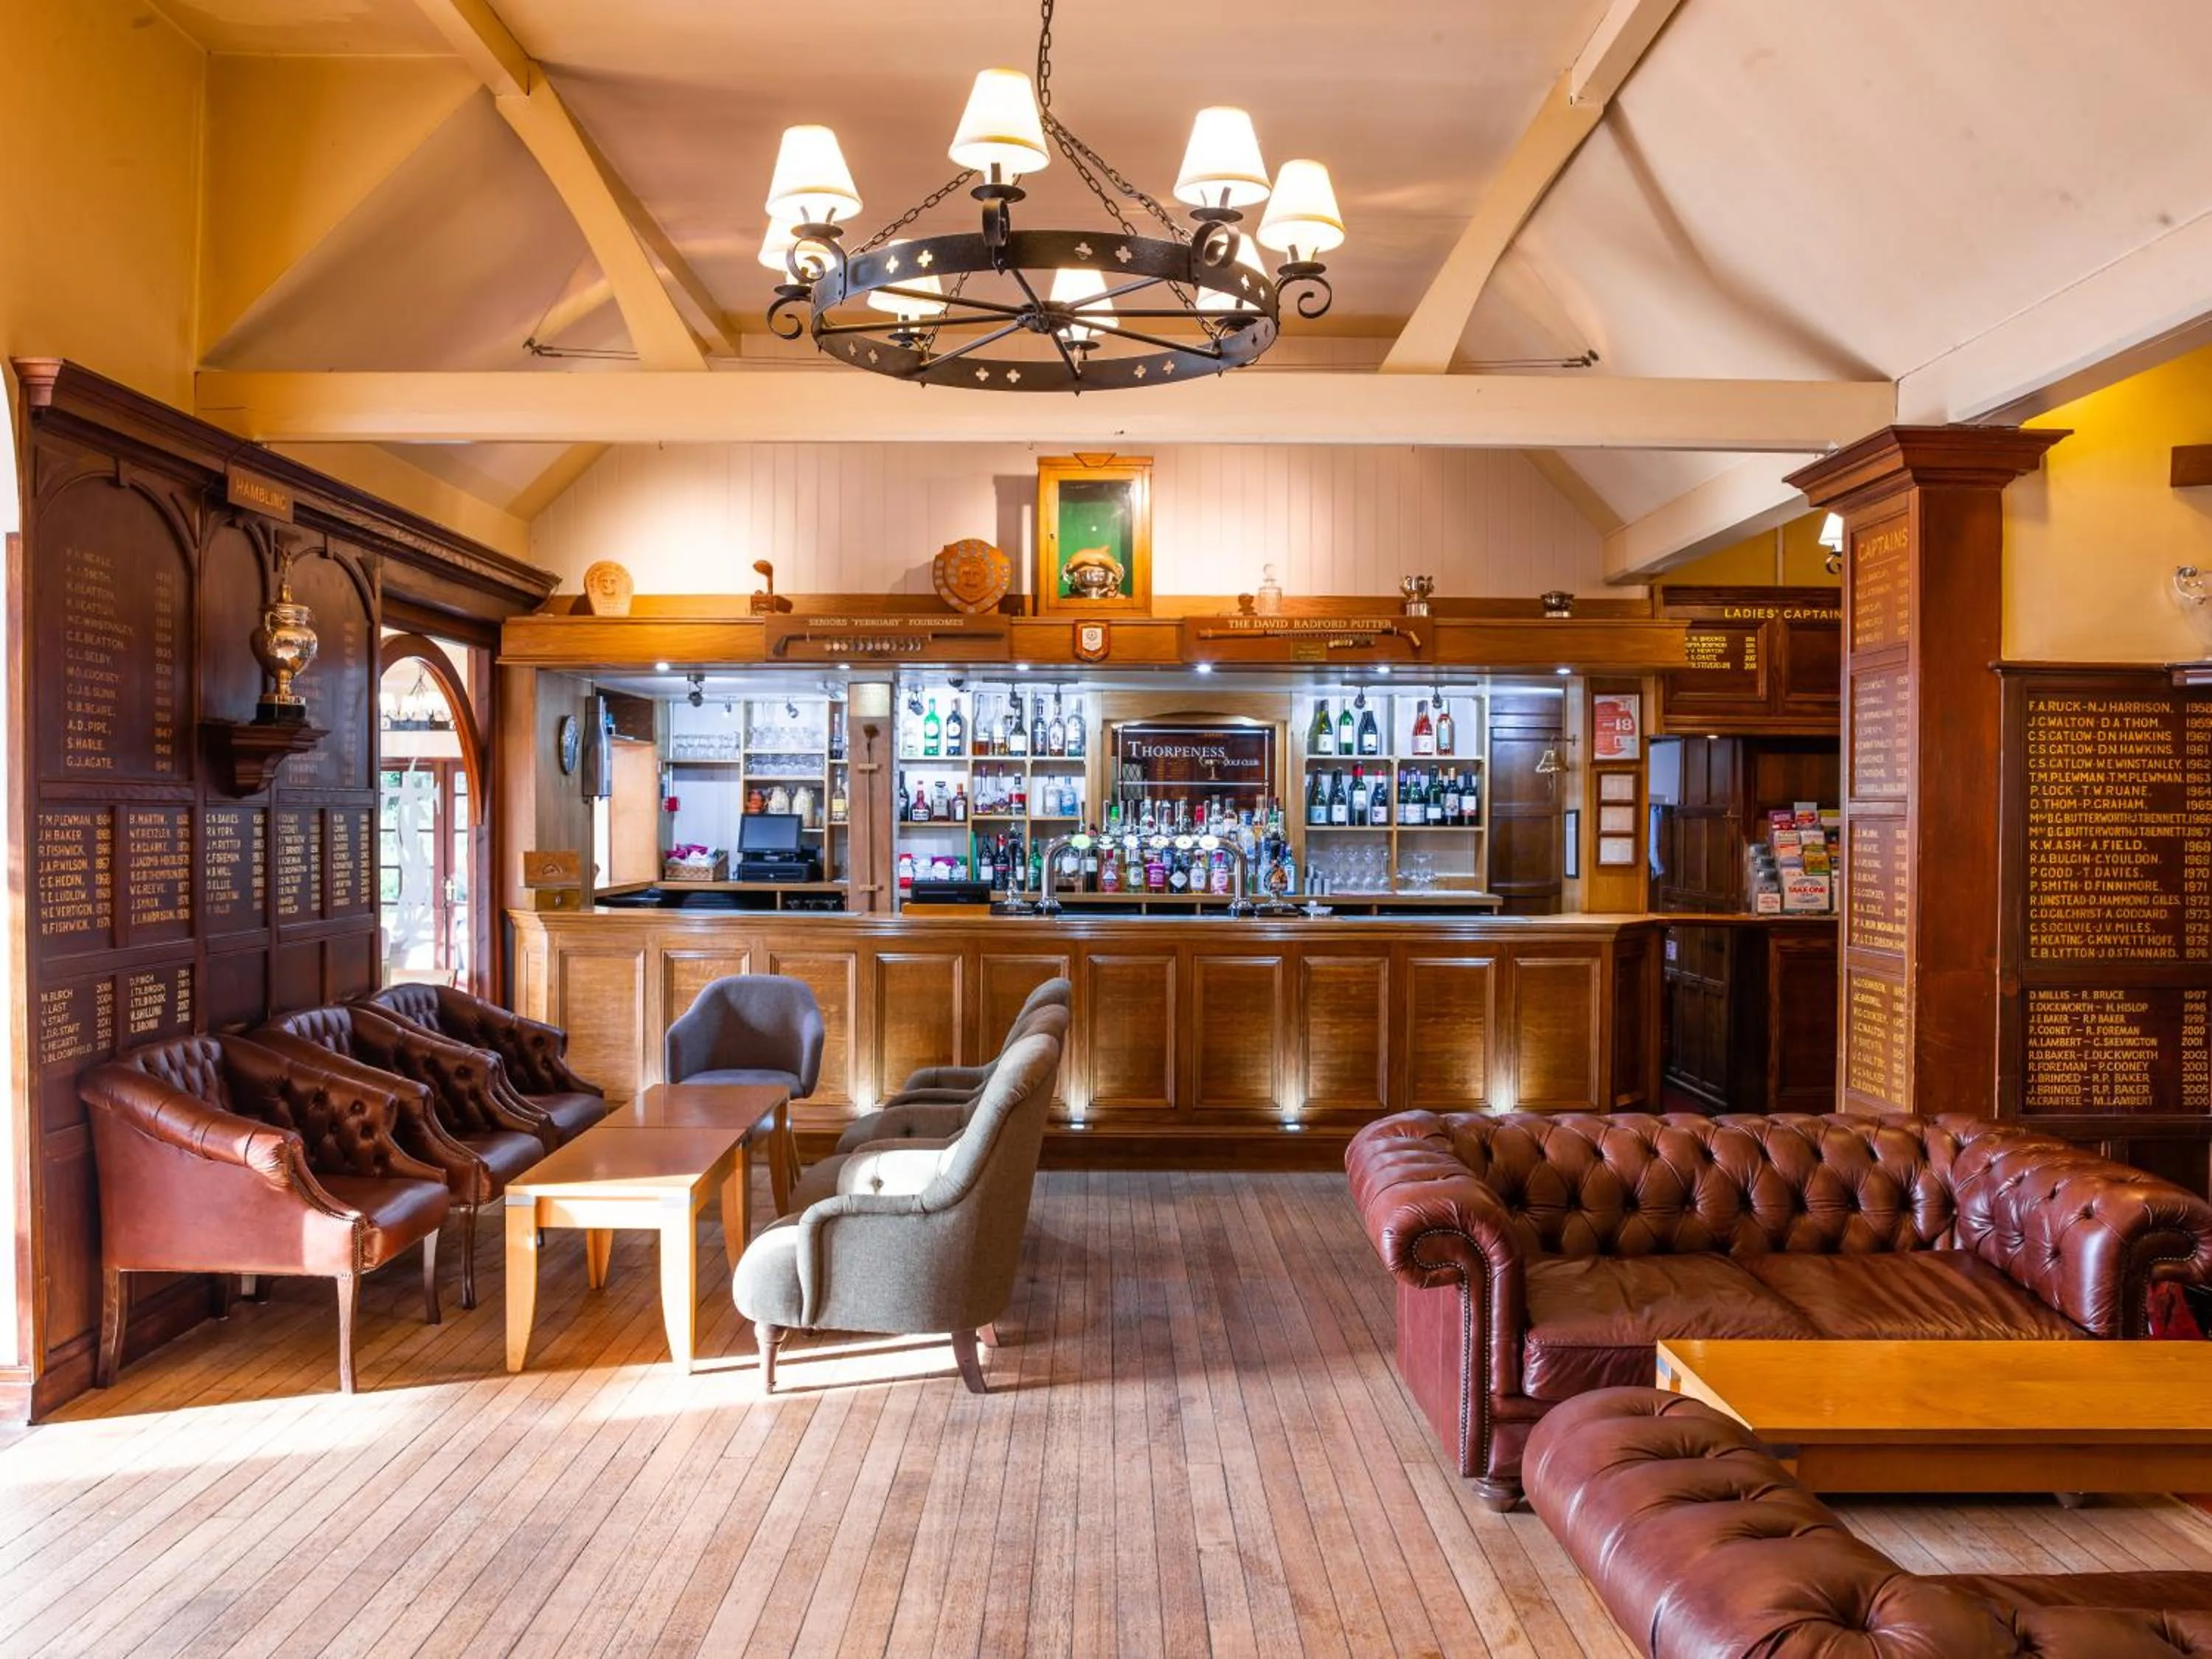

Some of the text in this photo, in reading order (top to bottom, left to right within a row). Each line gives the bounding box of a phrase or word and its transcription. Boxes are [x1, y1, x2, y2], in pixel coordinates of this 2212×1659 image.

[235, 479, 286, 510] HAMBLING
[1857, 528, 1908, 563] CAPTAINS
[1228, 619, 1391, 628] THE DAVID RADFORD PUTTER
[1615, 718, 1633, 731] 18
[2186, 745, 2209, 756] 1961
[2186, 759, 2211, 769] 1962
[2184, 868, 2211, 878] 1970
[2184, 881, 2208, 891] 1971
[2185, 895, 2211, 906] 1972
[2185, 908, 2211, 919] 1973
[2182, 1026, 2206, 1035] 2000
[2182, 1037, 2203, 1047] 2001
[2182, 1051, 2208, 1060] 2002
[2182, 1062, 2208, 1071] 2003
[2182, 1073, 2208, 1082] 2004
[2114, 1085, 2150, 1095] BAKER
[2182, 1085, 2208, 1095] 2005
[2182, 1096, 2210, 1106] 2006
